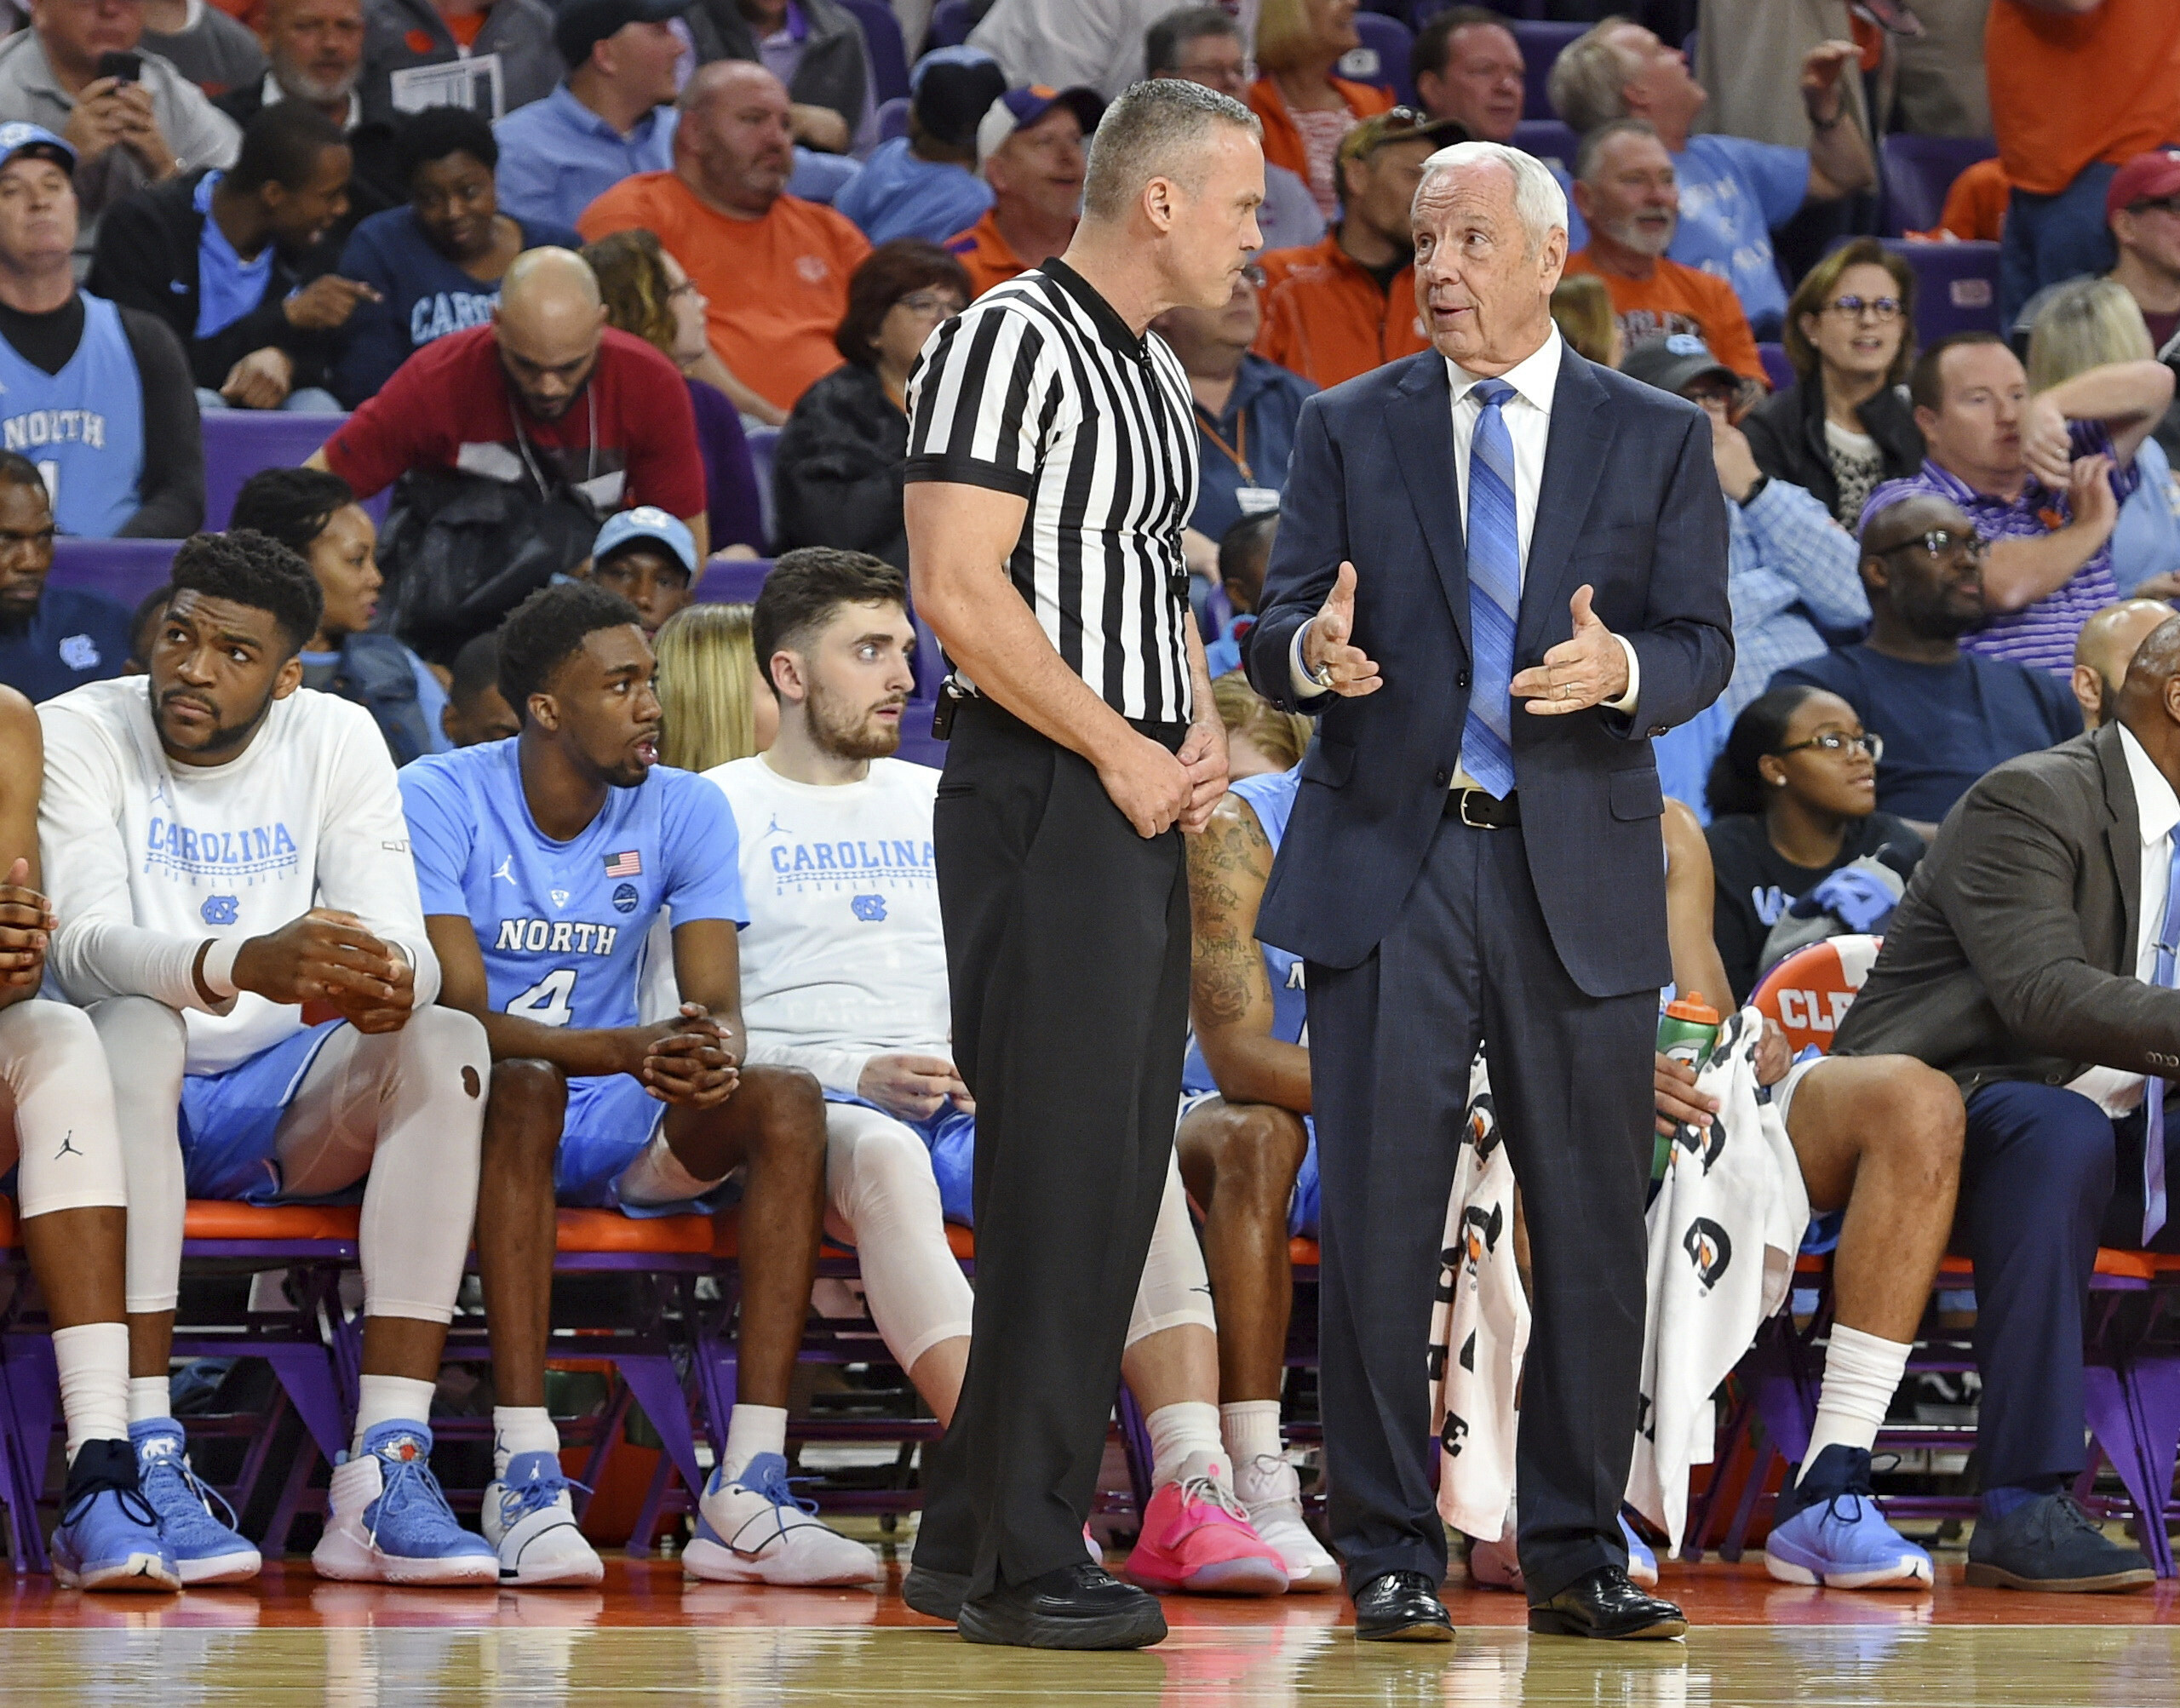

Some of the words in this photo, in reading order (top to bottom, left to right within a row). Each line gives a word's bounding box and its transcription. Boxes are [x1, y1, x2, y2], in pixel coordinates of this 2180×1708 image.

[147, 817, 296, 863] CAROLINA
[494, 918, 617, 955] NORTH
[505, 968, 577, 1027] 4
